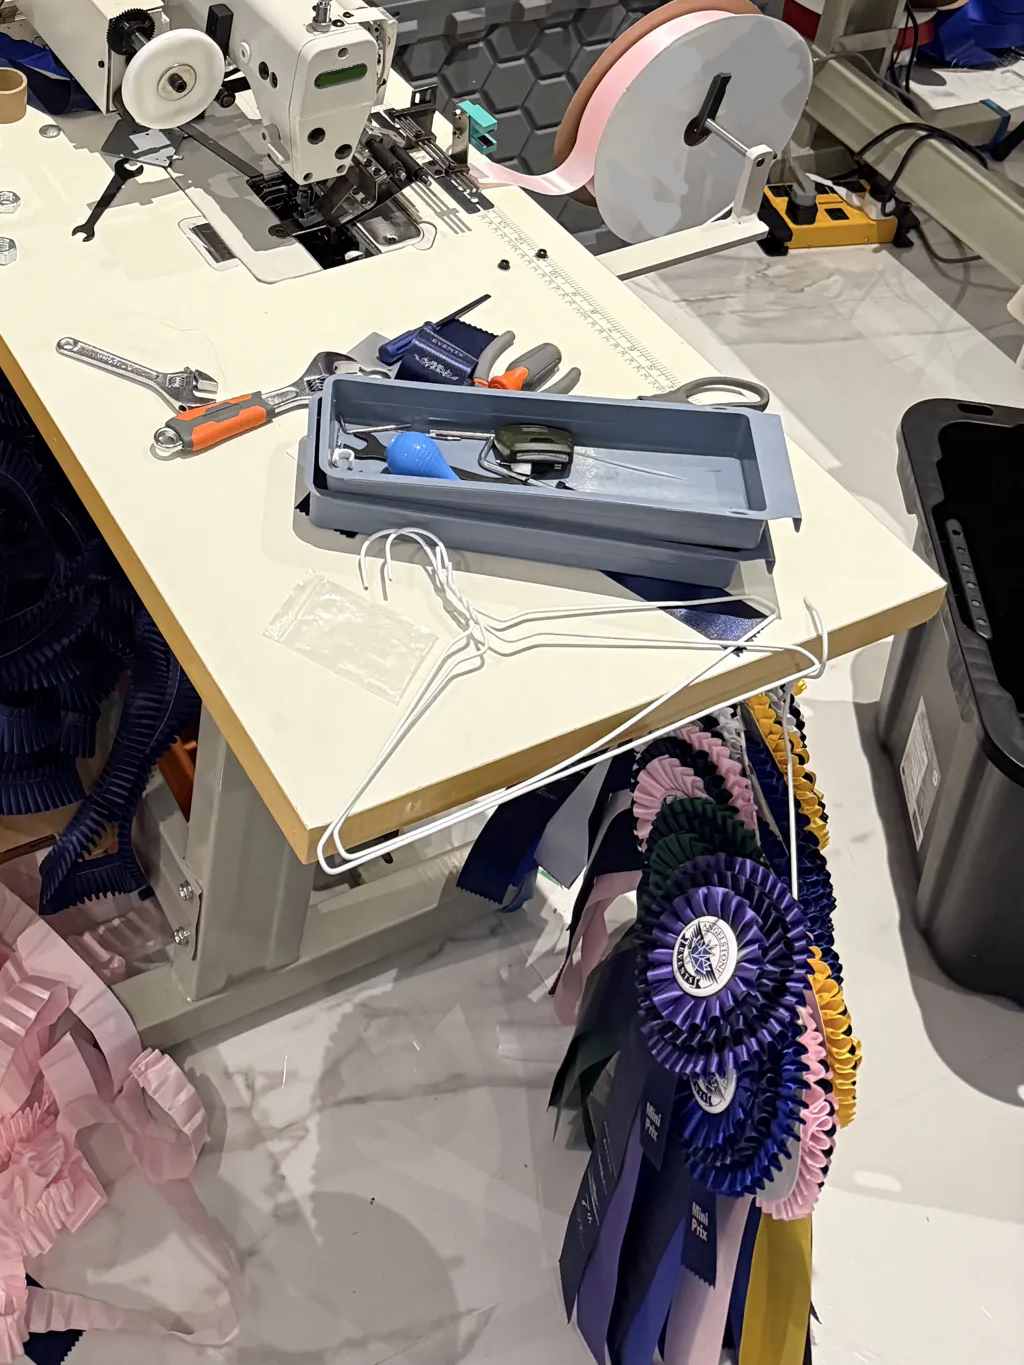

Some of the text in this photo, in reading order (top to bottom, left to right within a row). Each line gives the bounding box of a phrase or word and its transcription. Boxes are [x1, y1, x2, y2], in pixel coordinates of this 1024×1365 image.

[431, 337, 465, 358] EVENTS
[702, 923, 730, 980] ANGELSTONE
[676, 947, 696, 985] EVENTS
[645, 1101, 662, 1127] Mini
[644, 1119, 659, 1143] Prix
[691, 1201, 709, 1227] Mini
[690, 1218, 708, 1242] Prix
